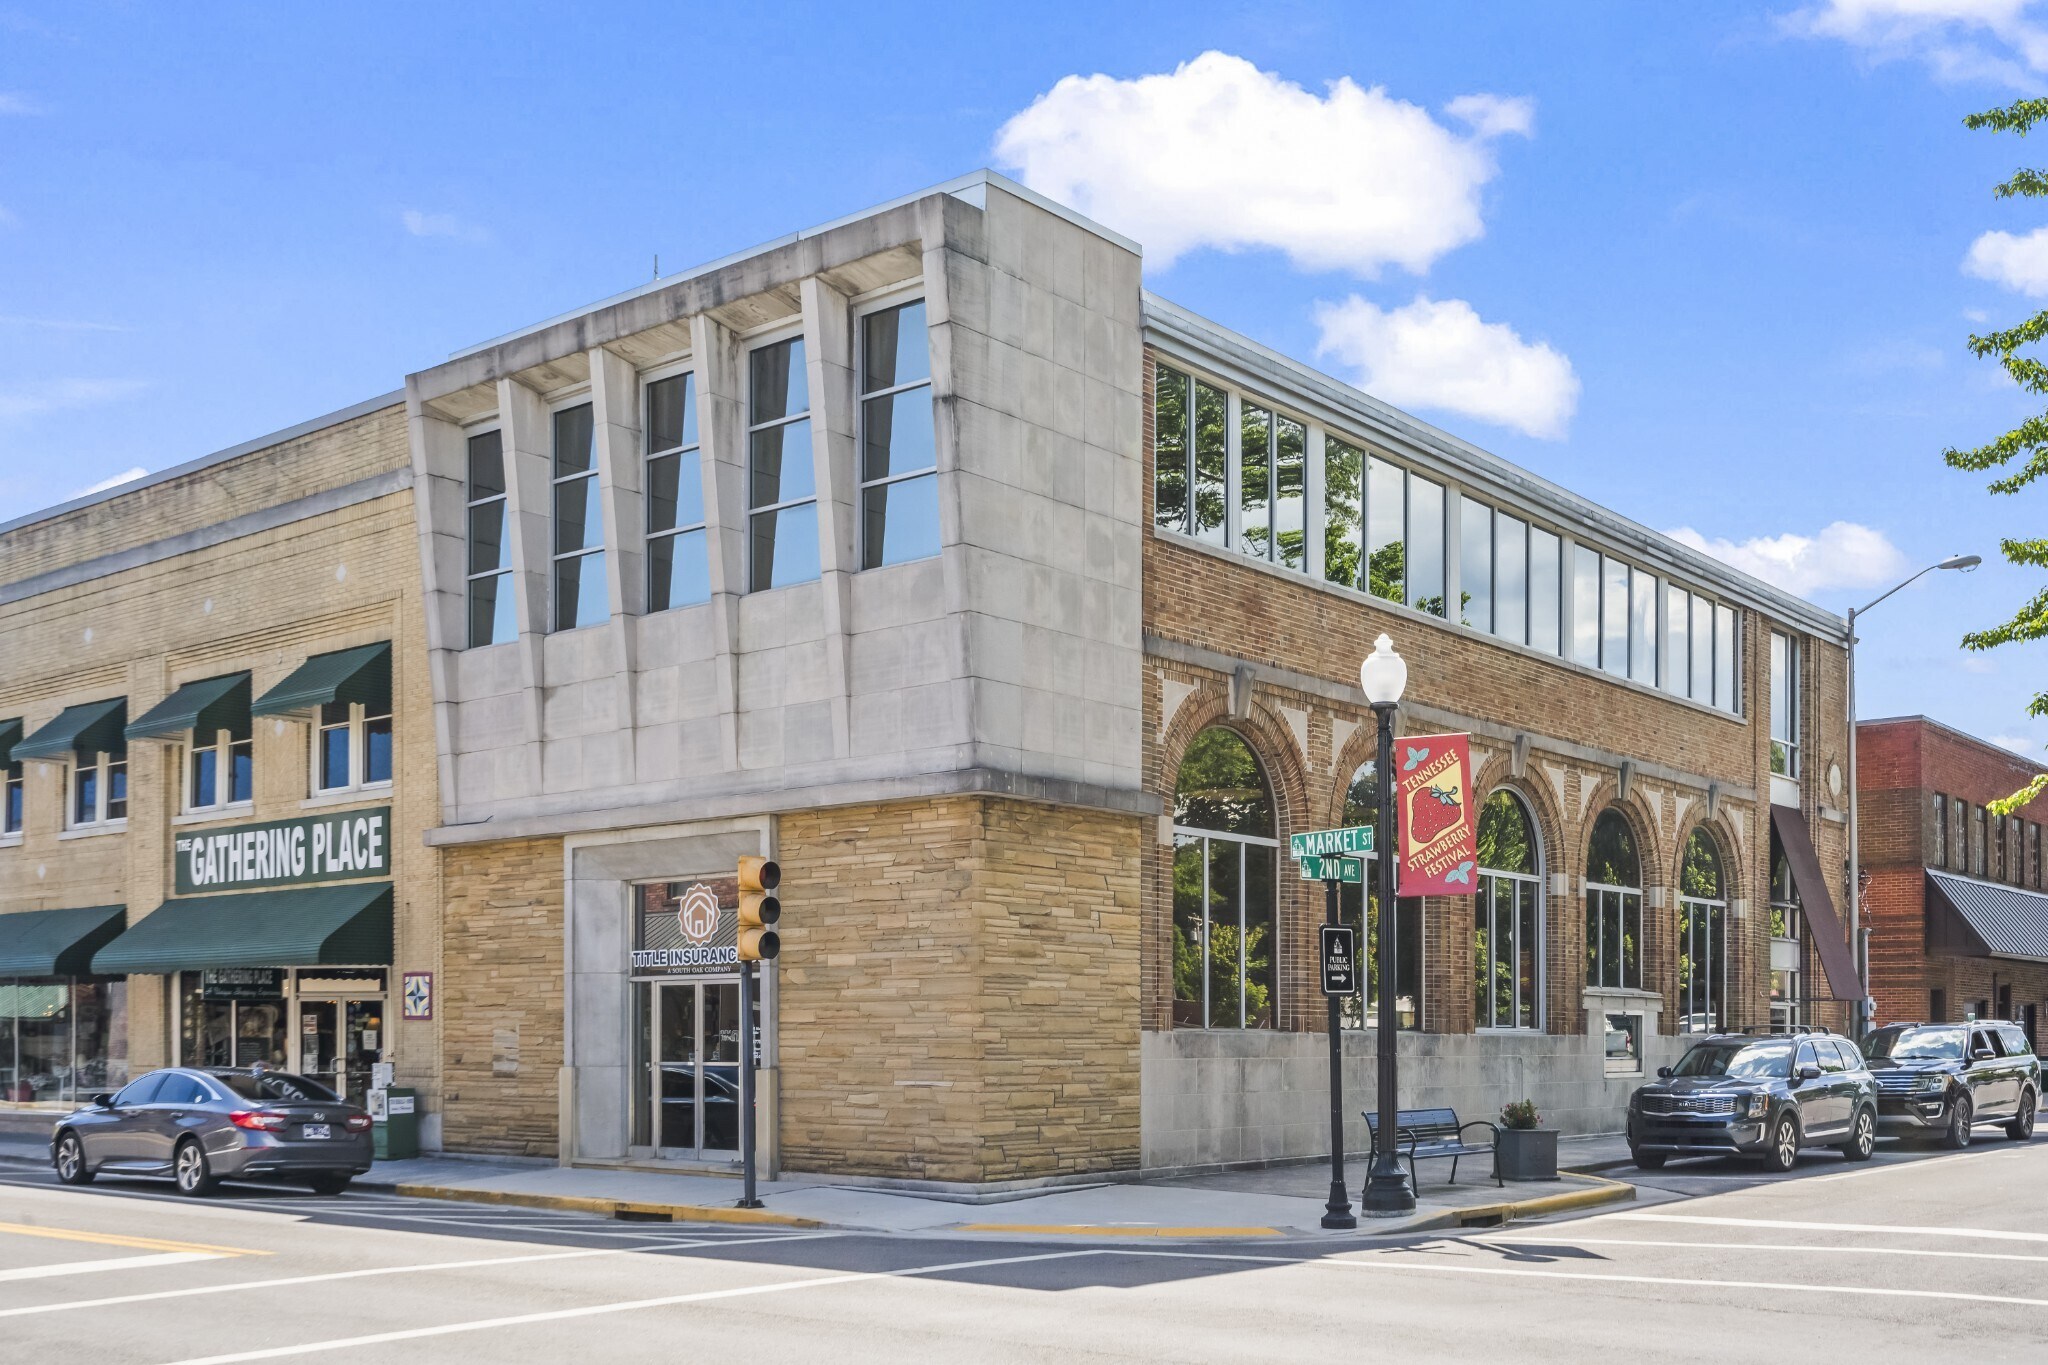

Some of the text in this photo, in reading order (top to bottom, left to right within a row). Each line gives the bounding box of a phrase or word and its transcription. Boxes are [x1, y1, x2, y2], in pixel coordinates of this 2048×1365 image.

[1402, 748, 1459, 792] TENNESSEE
[176, 816, 383, 885] THE GATHERING PLACE
[1305, 830, 1371, 855] MARKET ST
[1407, 824, 1471, 872] STRAWBERRY
[1319, 858, 1355, 879] 2ND AVE
[1424, 844, 1471, 878] FESTIVAL
[632, 946, 739, 967] TITLE INSURANC
[1327, 963, 1350, 971] PARKING
